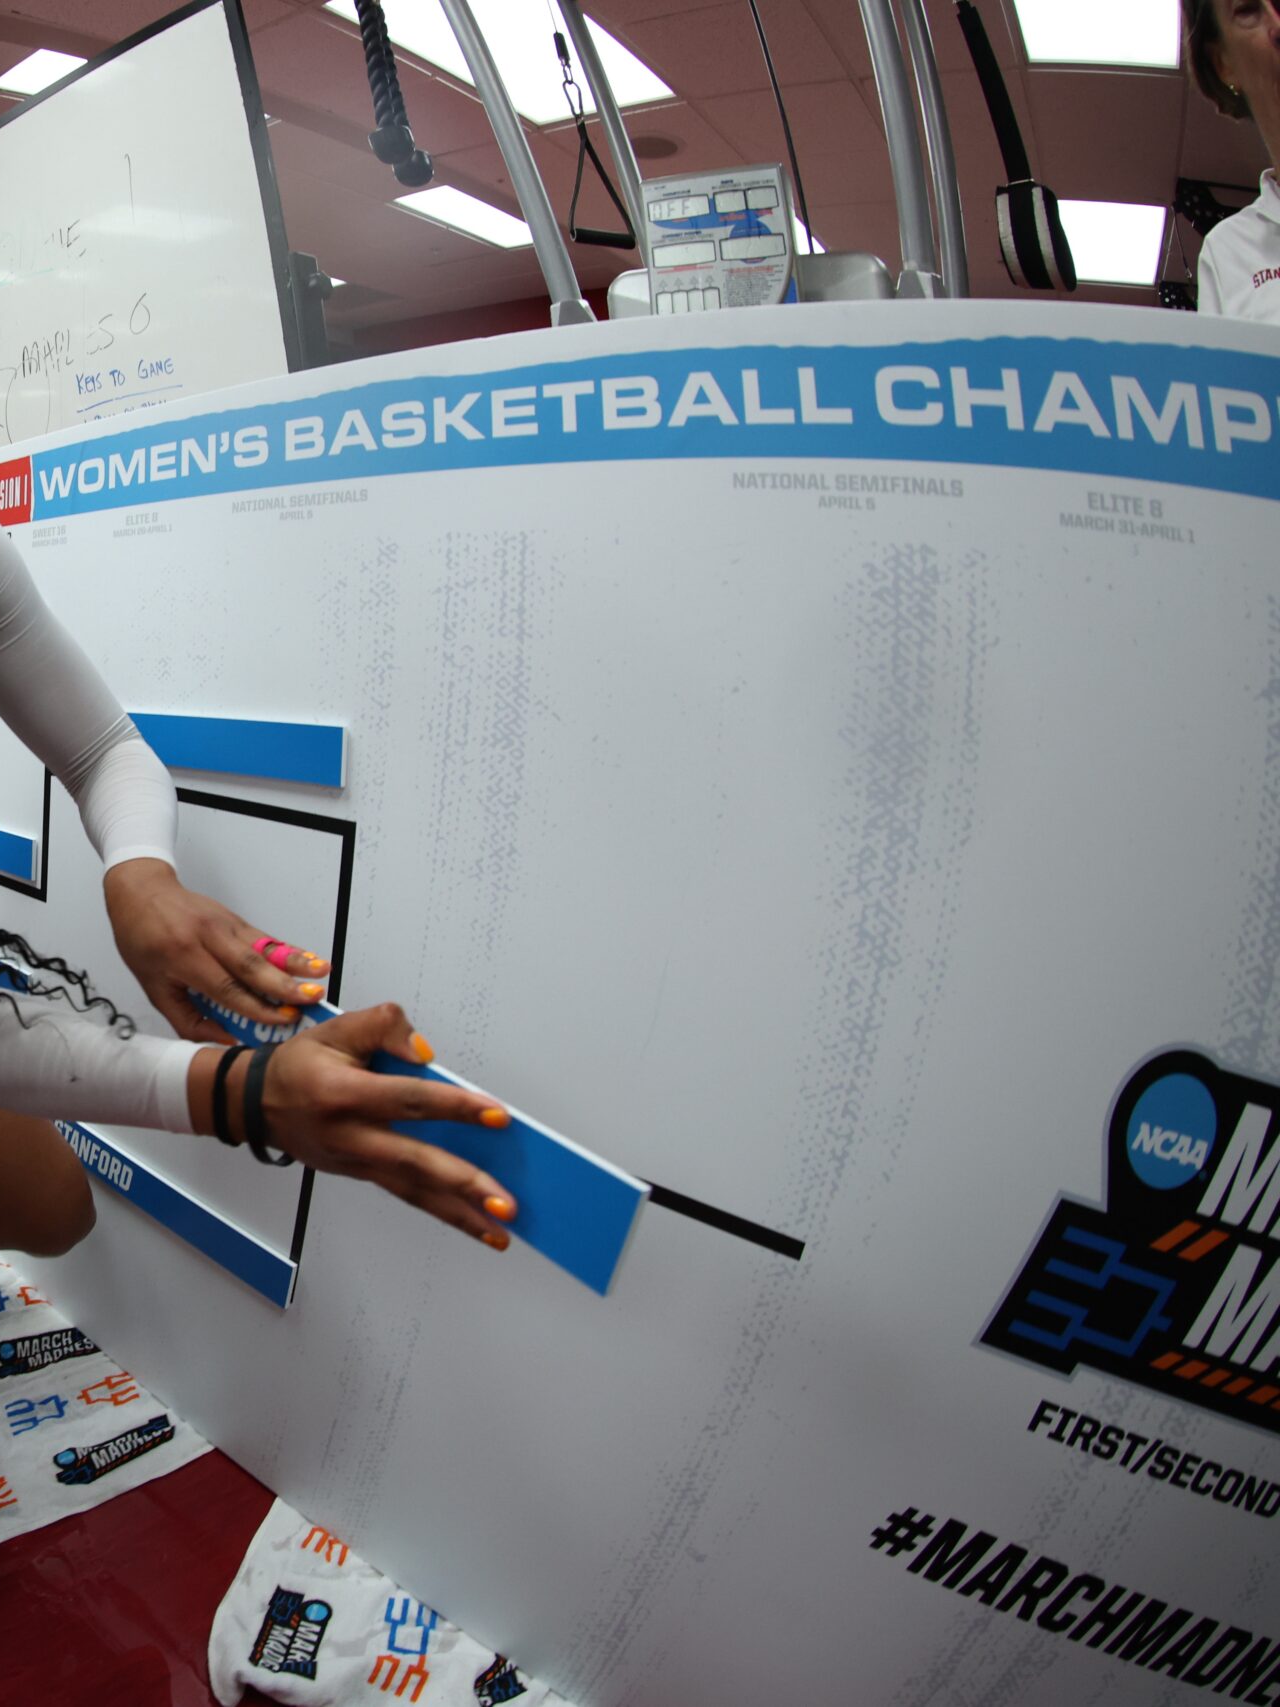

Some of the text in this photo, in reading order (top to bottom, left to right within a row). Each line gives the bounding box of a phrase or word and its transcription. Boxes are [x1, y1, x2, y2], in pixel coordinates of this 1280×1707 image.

[109, 368, 126, 387] TO
[137, 357, 175, 380] GAME
[39, 425, 269, 502] WOMEN'S
[284, 367, 854, 462] BASKETBALL
[873, 365, 1280, 453] CHAMP
[732, 472, 964, 498] NATIONAL SEMIFINALS
[231, 489, 368, 514] NATIONAL SEMIFINALS
[818, 496, 862, 510] APRIL
[1087, 492, 1163, 519] ELITE 8
[125, 513, 150, 527] ELITE
[279, 511, 305, 521] APRIL
[1059, 512, 1115, 533] MARCH
[1131, 1121, 1209, 1171] NCAA
[1195, 1102, 1280, 1242] M
[16, 1332, 73, 1359] MARCH
[869, 1507, 1280, 1707] #MARCHMADNE
